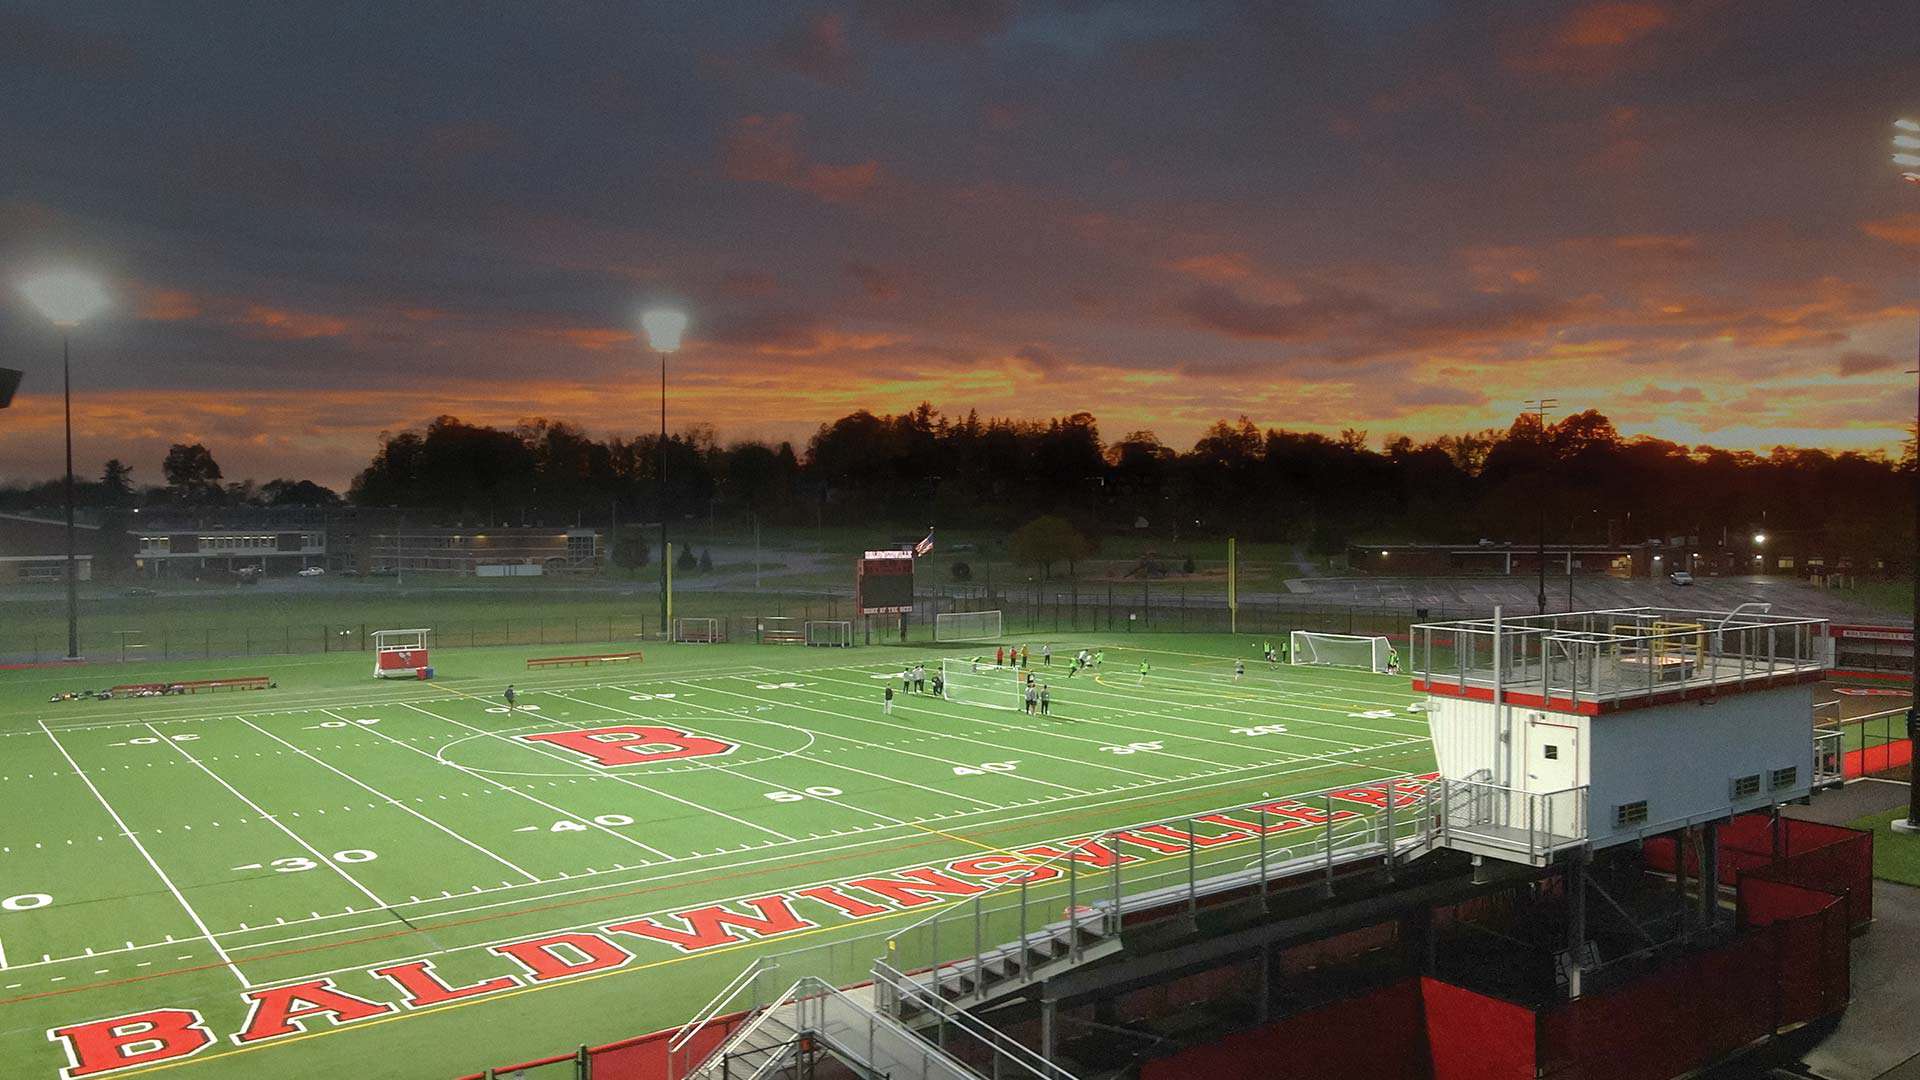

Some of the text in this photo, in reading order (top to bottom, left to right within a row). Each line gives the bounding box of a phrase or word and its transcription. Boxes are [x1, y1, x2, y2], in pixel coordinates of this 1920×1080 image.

[511, 725, 741, 767] B
[953, 762, 1016, 775] 40
[764, 786, 843, 801] 50
[550, 814, 634, 832] 40
[270, 849, 378, 872] 30
[46, 799, 1364, 1080] BALDWINSVILLE
